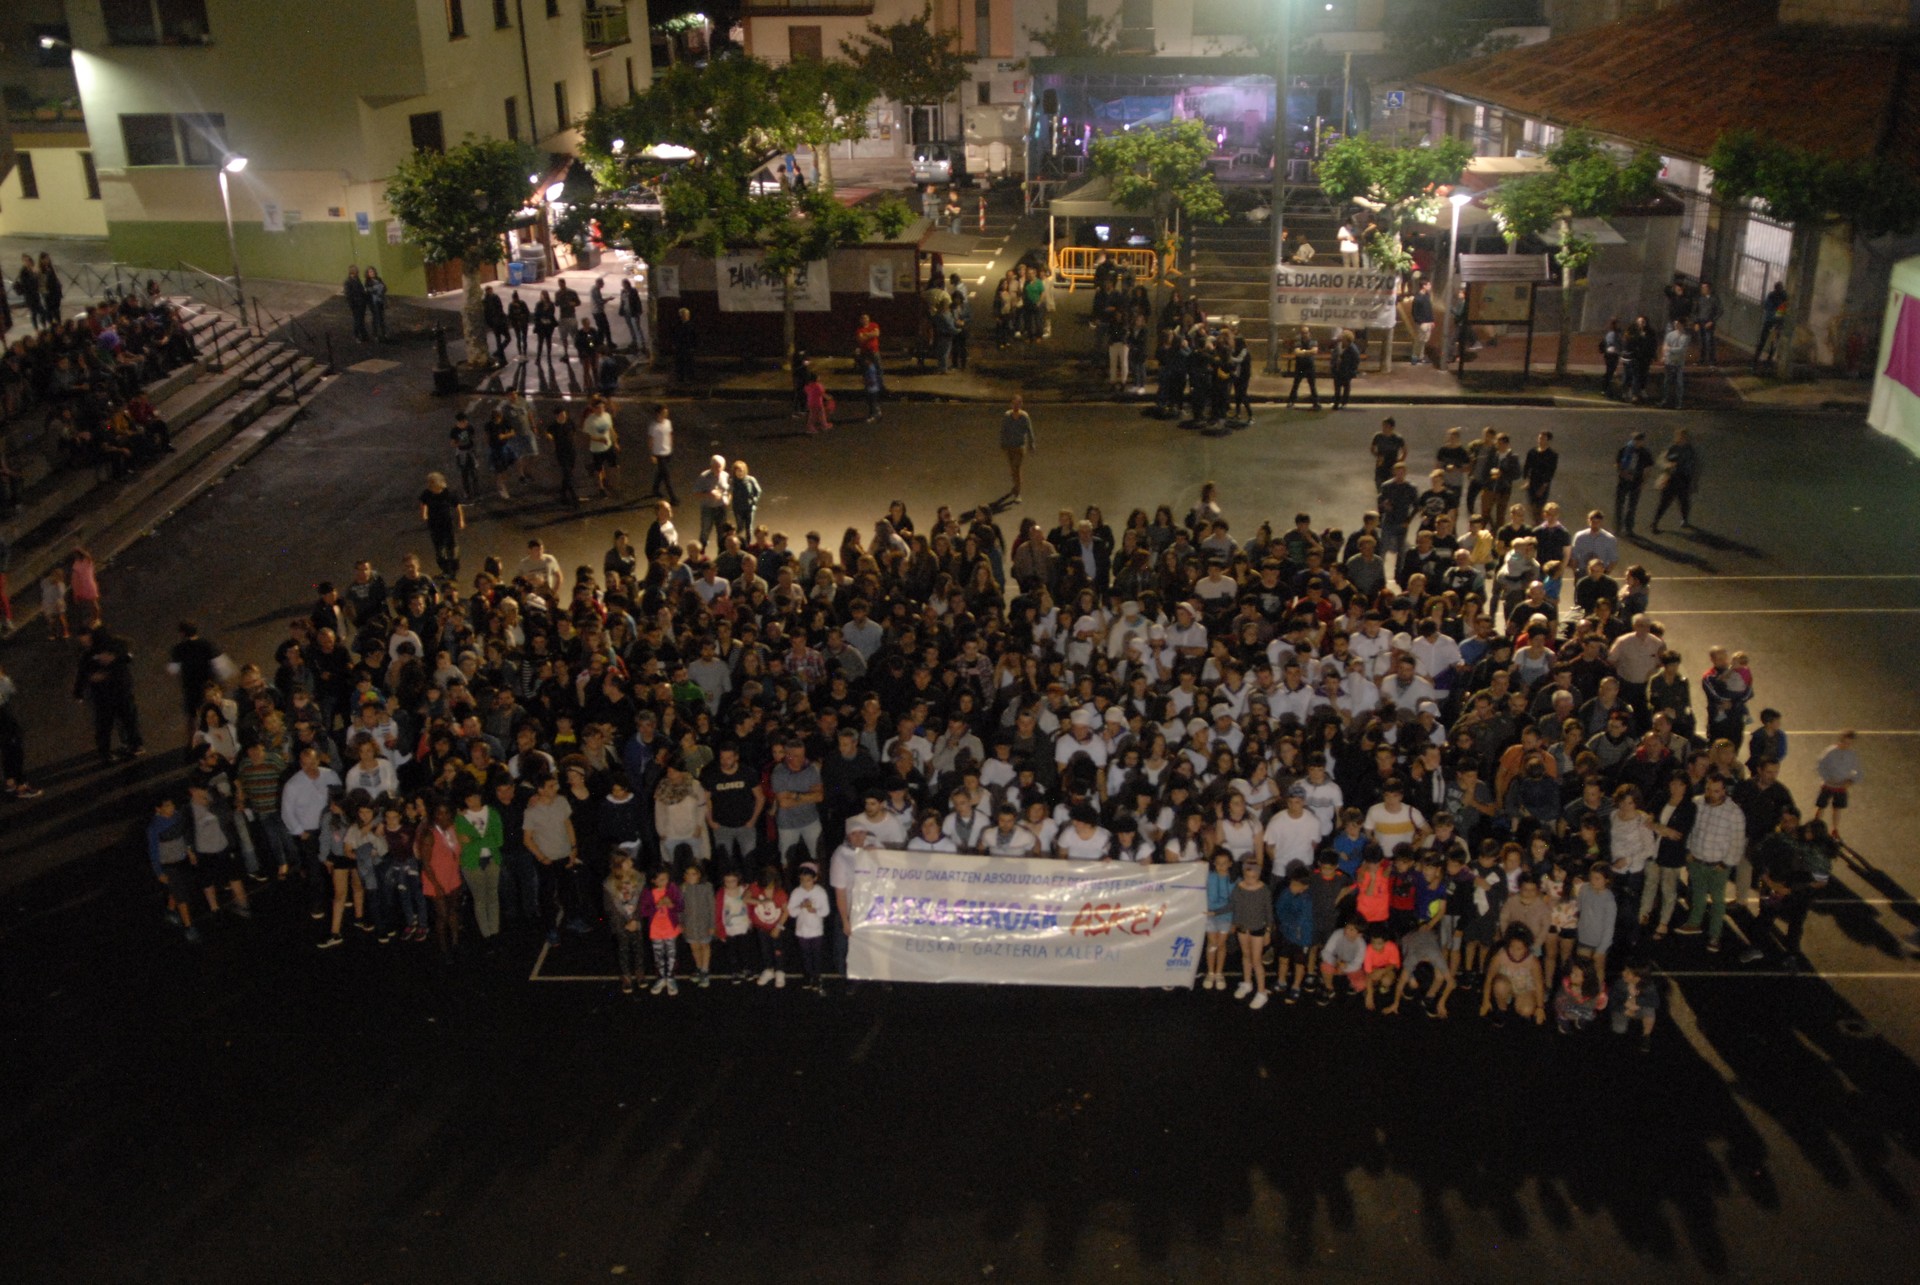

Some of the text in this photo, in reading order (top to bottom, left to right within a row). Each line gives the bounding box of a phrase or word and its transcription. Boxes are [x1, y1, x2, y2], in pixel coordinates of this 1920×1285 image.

[1276, 273, 1292, 287] EL
[1294, 273, 1344, 288] DIARIO
[876, 867, 889, 879] EZ
[892, 868, 921, 881] DUGU
[924, 869, 982, 884] ONARTZEN
[905, 938, 965, 954] EUSKAL
[973, 942, 1048, 959] GAZTERIA
